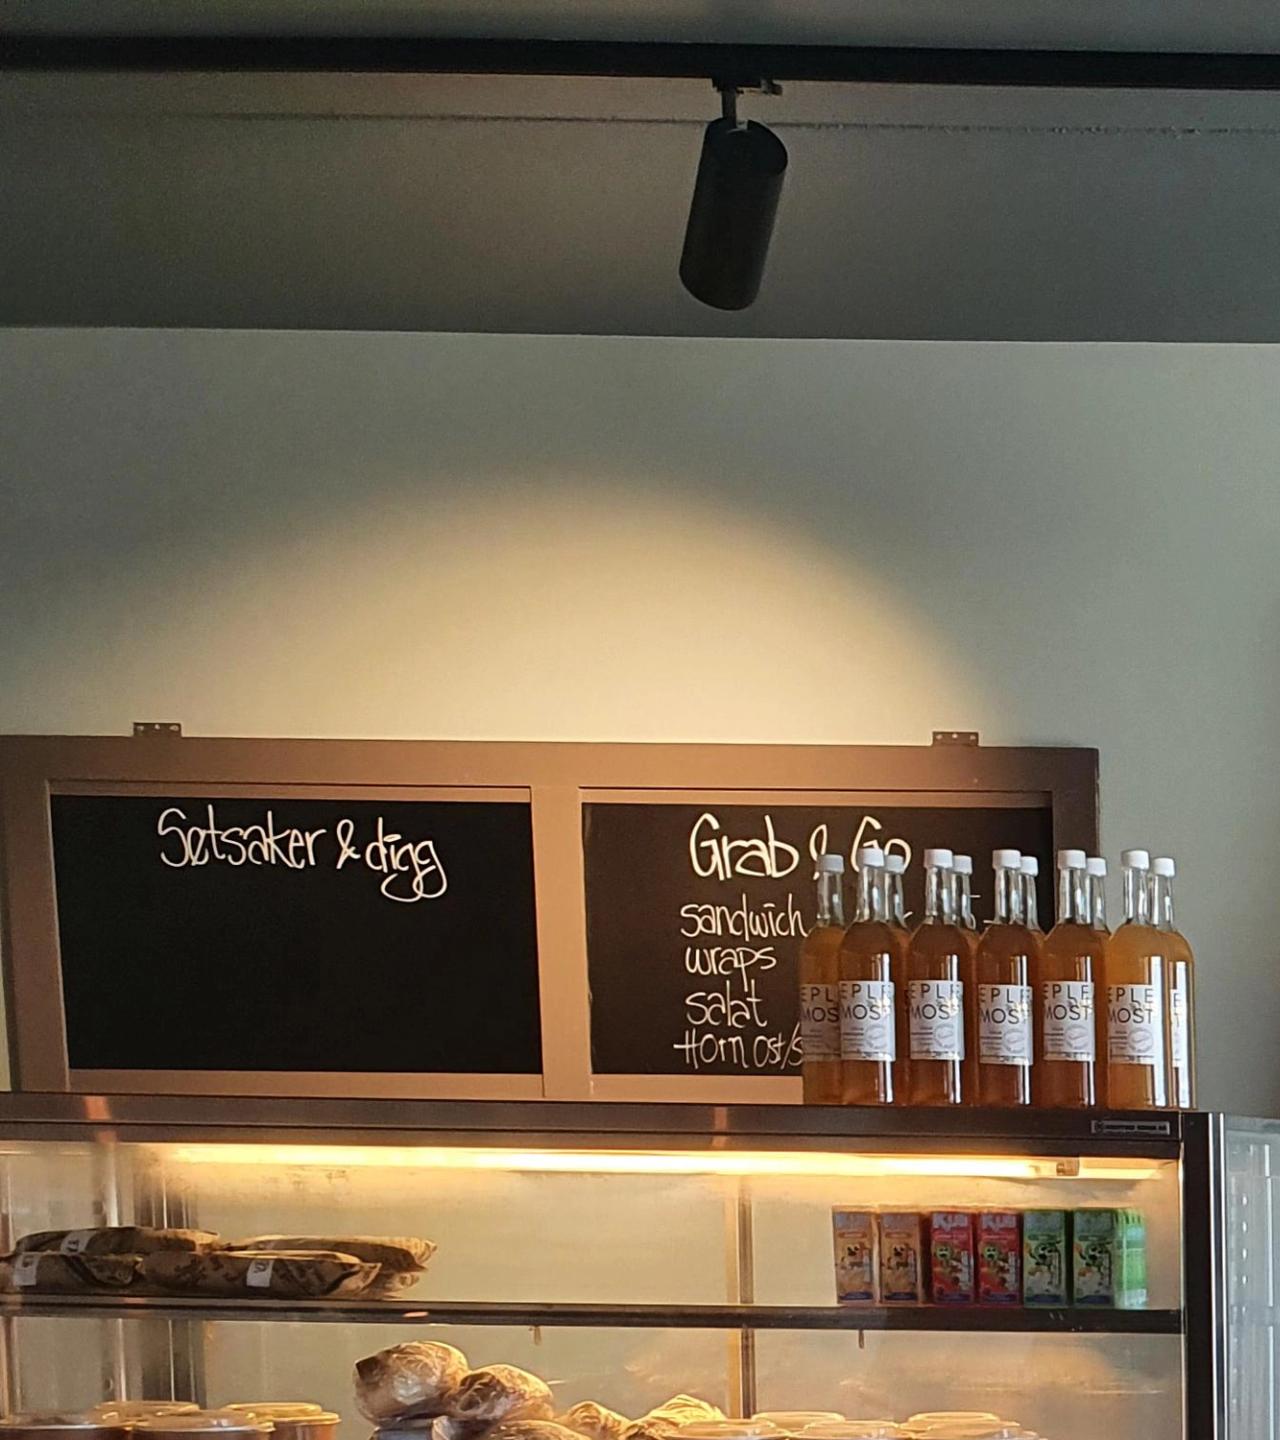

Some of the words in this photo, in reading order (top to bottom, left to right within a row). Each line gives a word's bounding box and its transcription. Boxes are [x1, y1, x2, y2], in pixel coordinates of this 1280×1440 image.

[157, 803, 328, 868] Søtsaker
[336, 818, 361, 870] &
[365, 816, 448, 903] digg
[689, 812, 801, 881] Grab
[849, 815, 912, 876] Go
[680, 893, 809, 942] sandwich
[685, 945, 777, 993] wraps
[685, 979, 768, 1029] salat
[801, 986, 834, 1002] EPL
[801, 1006, 840, 1023] MOS
